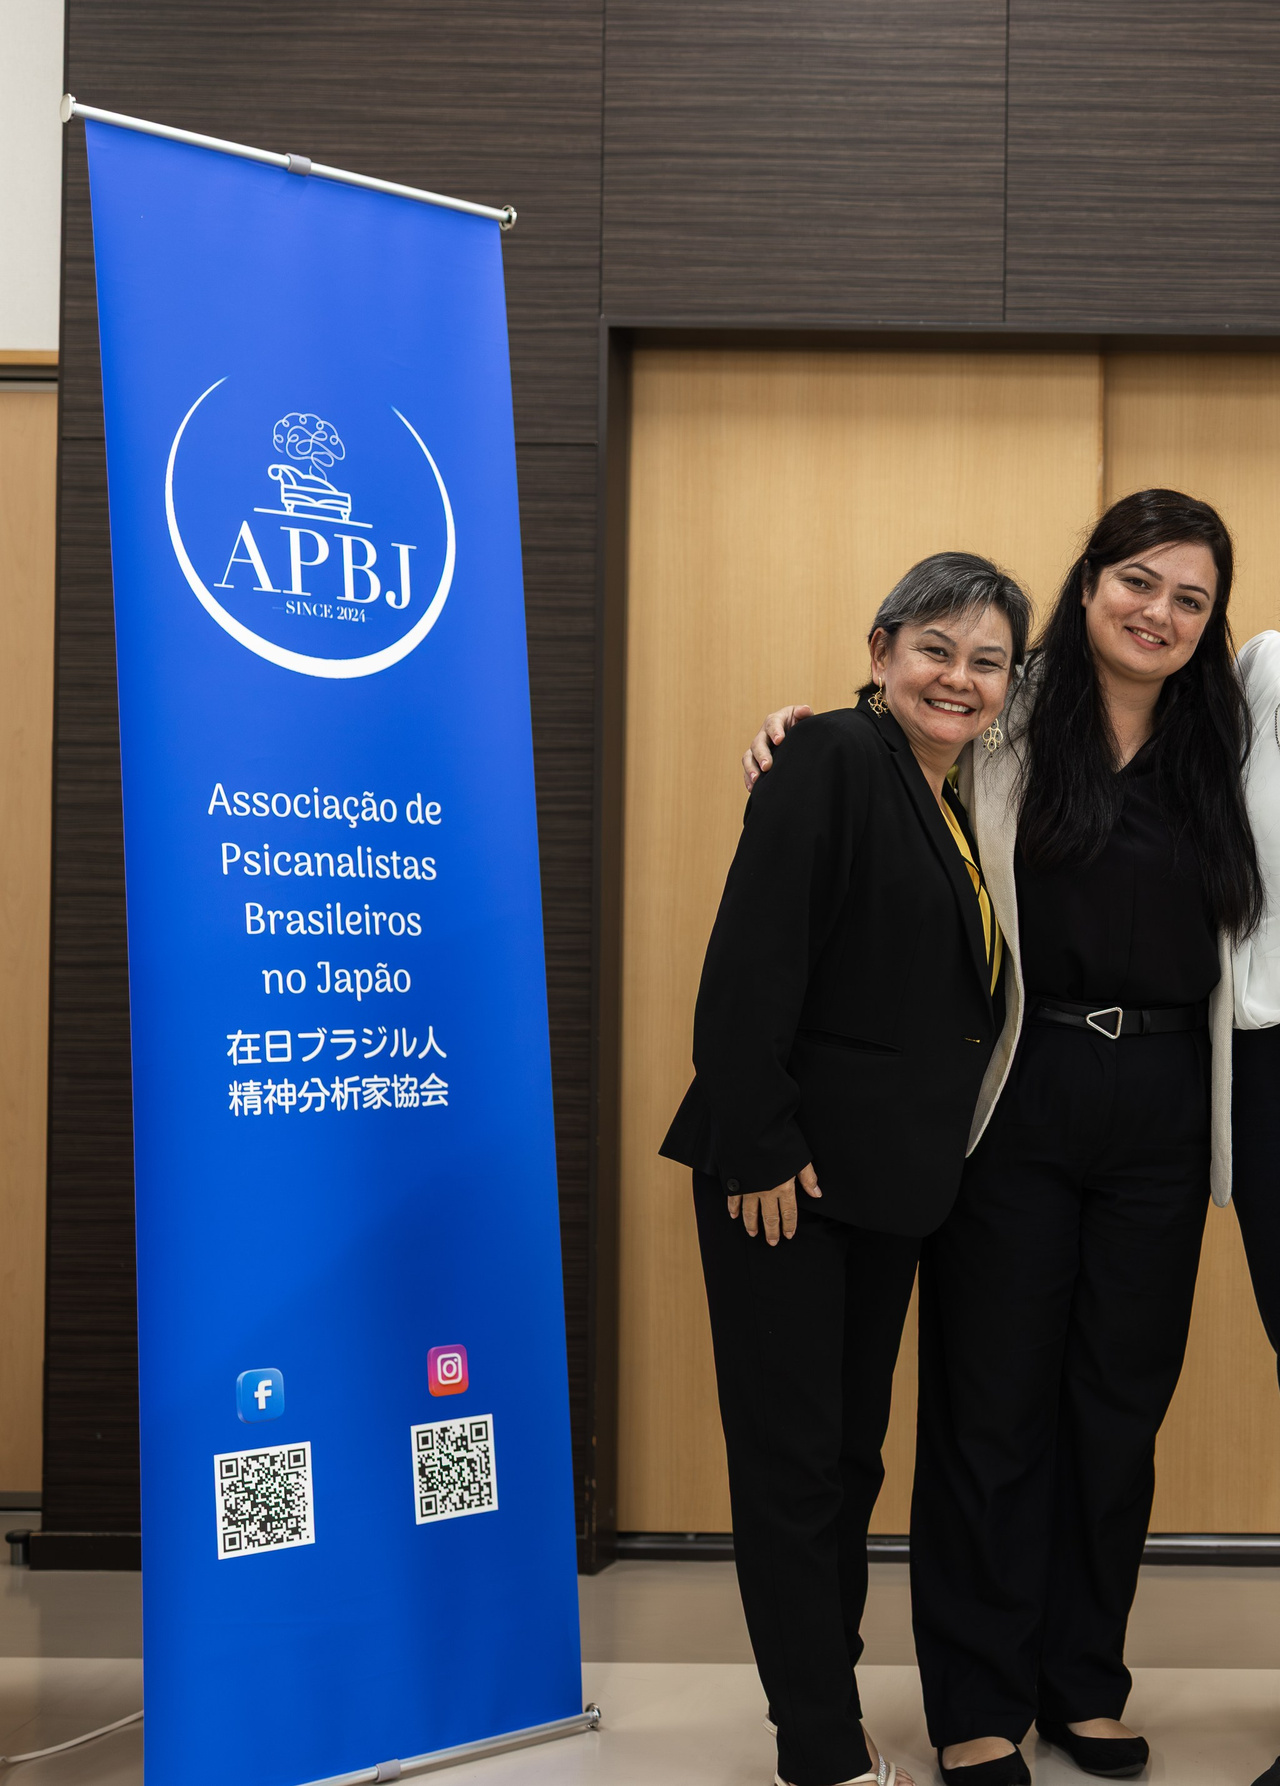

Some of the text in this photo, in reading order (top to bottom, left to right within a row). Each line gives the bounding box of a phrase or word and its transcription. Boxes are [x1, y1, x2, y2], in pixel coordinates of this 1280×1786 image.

[214, 520, 416, 610] APBJ
[286, 600, 365, 622] SINCE 2024
[208, 783, 442, 828] Associação de
[221, 842, 437, 881] Psicanalistas
[245, 902, 422, 936] Brasileiros
[262, 961, 411, 1002] no Japão
[226, 1026, 447, 1066] 在日ブラジル人
[228, 1072, 448, 1116] 精神分析家協会
[254, 1380, 272, 1410] f
